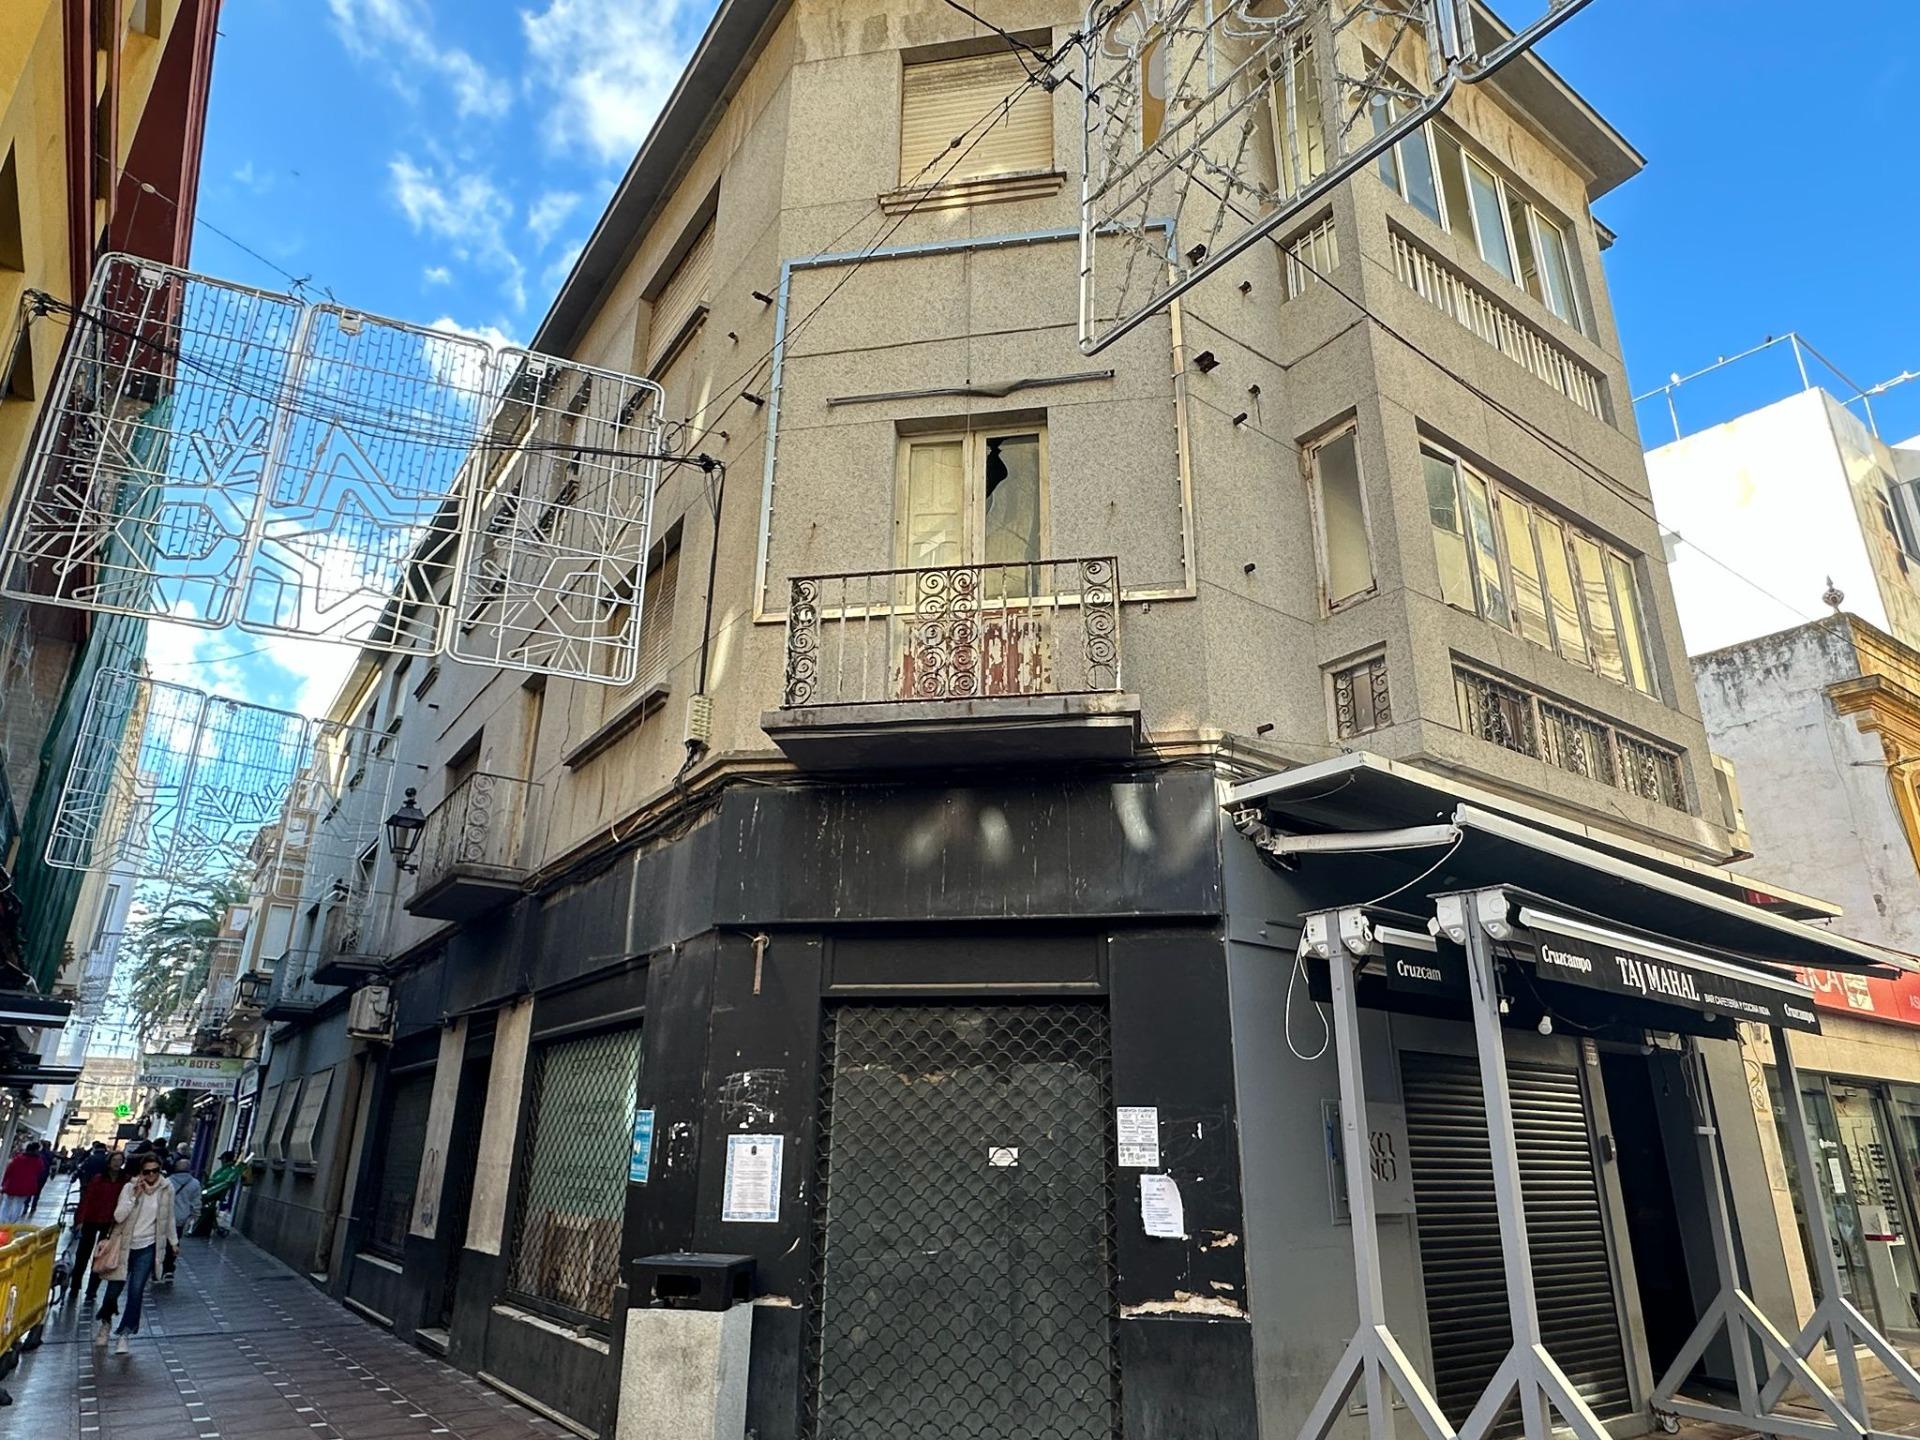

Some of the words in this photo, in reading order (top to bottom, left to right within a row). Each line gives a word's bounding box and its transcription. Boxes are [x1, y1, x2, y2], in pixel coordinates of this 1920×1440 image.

[1541, 944, 1592, 973] Cruzcampo
[1615, 956, 1647, 995] TAJ
[1644, 963, 1700, 1001] MAHAL
[189, 1059, 221, 1069] BOTES
